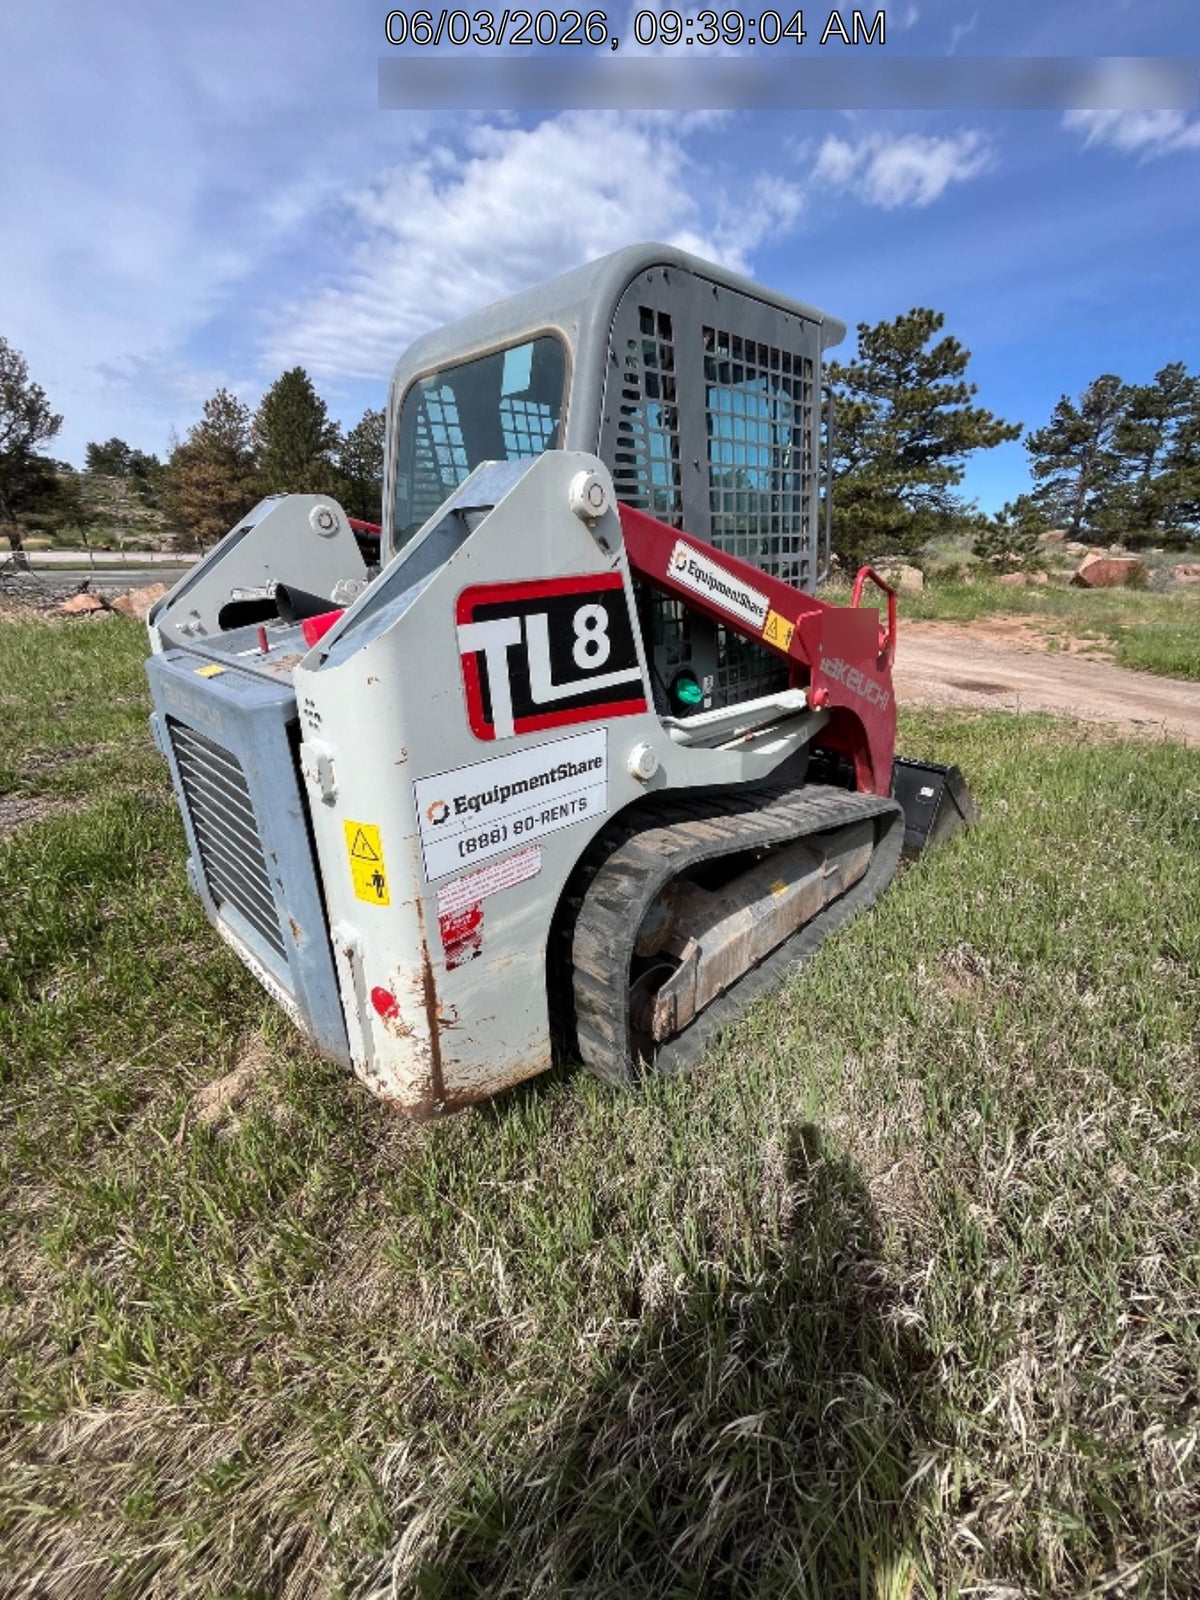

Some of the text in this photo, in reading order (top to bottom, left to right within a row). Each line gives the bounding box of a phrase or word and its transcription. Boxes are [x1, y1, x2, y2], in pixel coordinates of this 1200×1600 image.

[687, 559, 764, 618] EquipmentShare
[456, 603, 642, 740] TL8
[453, 755, 603, 816] EquipmentShare
[458, 796, 588, 858] (888) 80-RENTS
